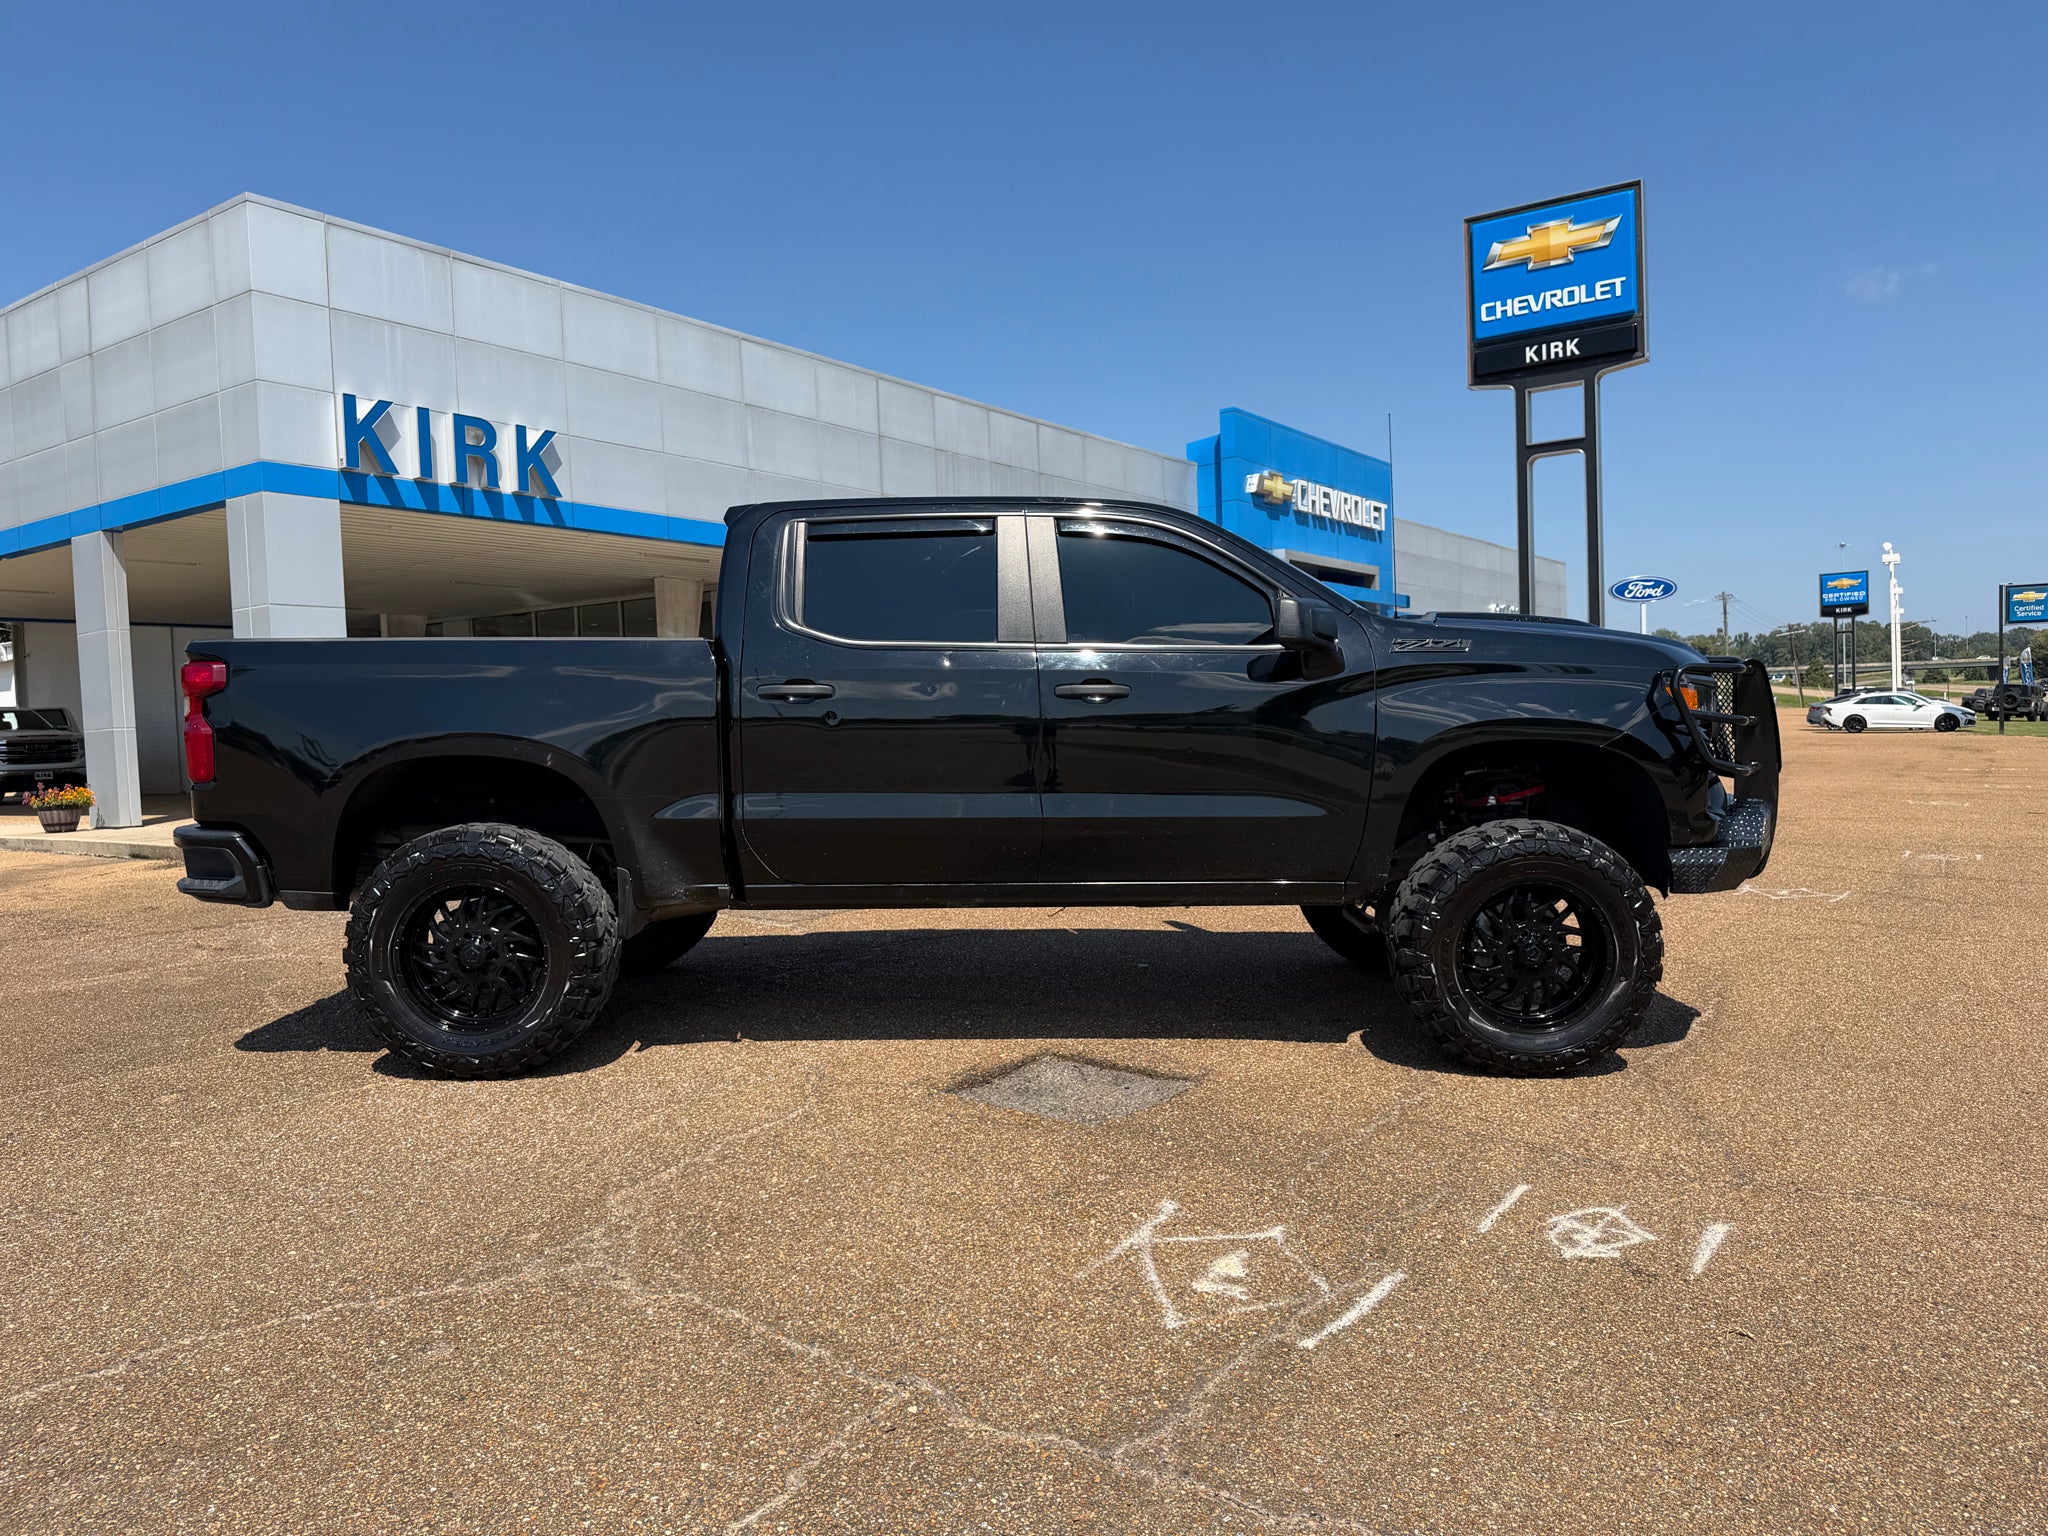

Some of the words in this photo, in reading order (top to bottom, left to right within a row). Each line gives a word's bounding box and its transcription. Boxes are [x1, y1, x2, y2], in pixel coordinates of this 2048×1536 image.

[1480, 276, 1627, 322] CHEVROLET
[1525, 337, 1581, 364] KIRK
[340, 392, 563, 498] KIRK
[1293, 479, 1388, 531] CHEVROLET
[1624, 581, 1665, 598] Ford
[1822, 590, 1866, 599] CERTIFIED
[2014, 604, 2045, 612] Certified
